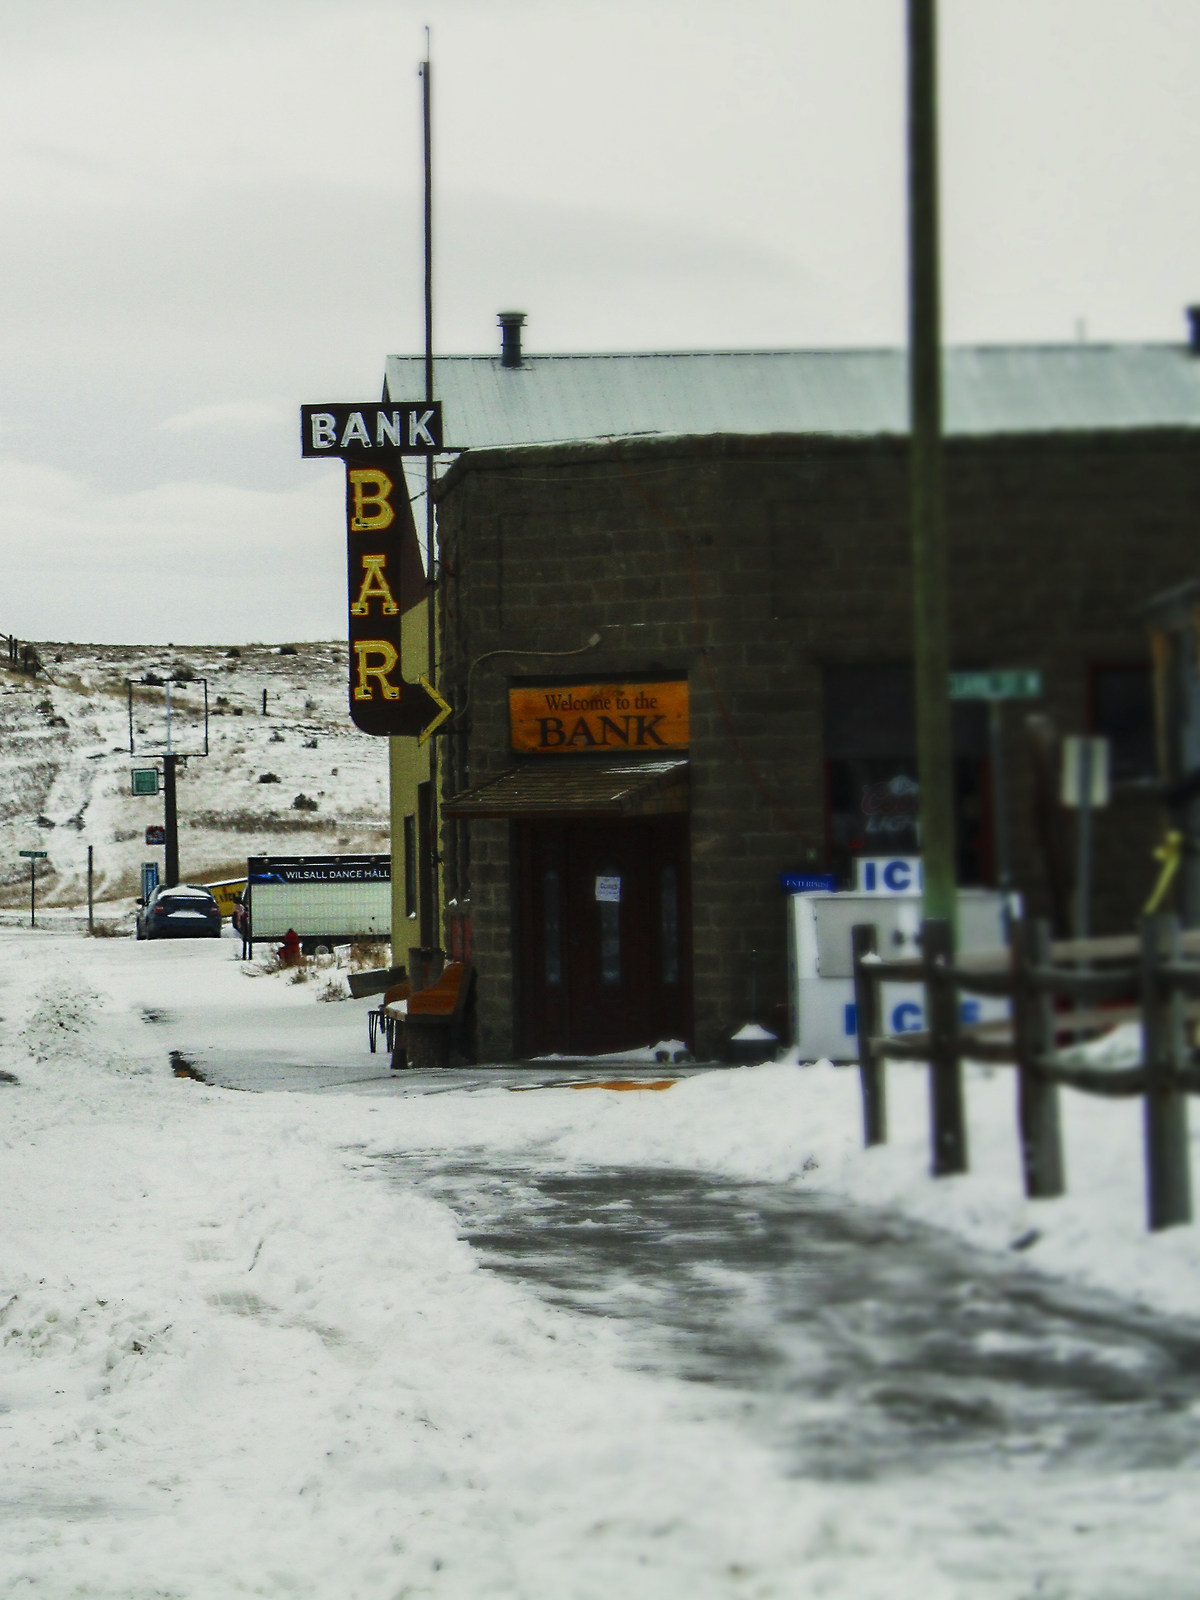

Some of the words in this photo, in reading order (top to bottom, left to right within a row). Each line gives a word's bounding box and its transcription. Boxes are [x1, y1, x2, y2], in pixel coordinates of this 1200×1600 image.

[310, 410, 436, 450] BANK
[349, 469, 401, 701] BAR
[545, 694, 611, 712] Welcome
[616, 695, 630, 710] to
[635, 691, 658, 710] the
[536, 715, 669, 748] BANK
[285, 871, 328, 879] WILSALL
[329, 870, 362, 879] DANCE
[364, 869, 390, 878] HALL
[865, 860, 922, 891] IC
